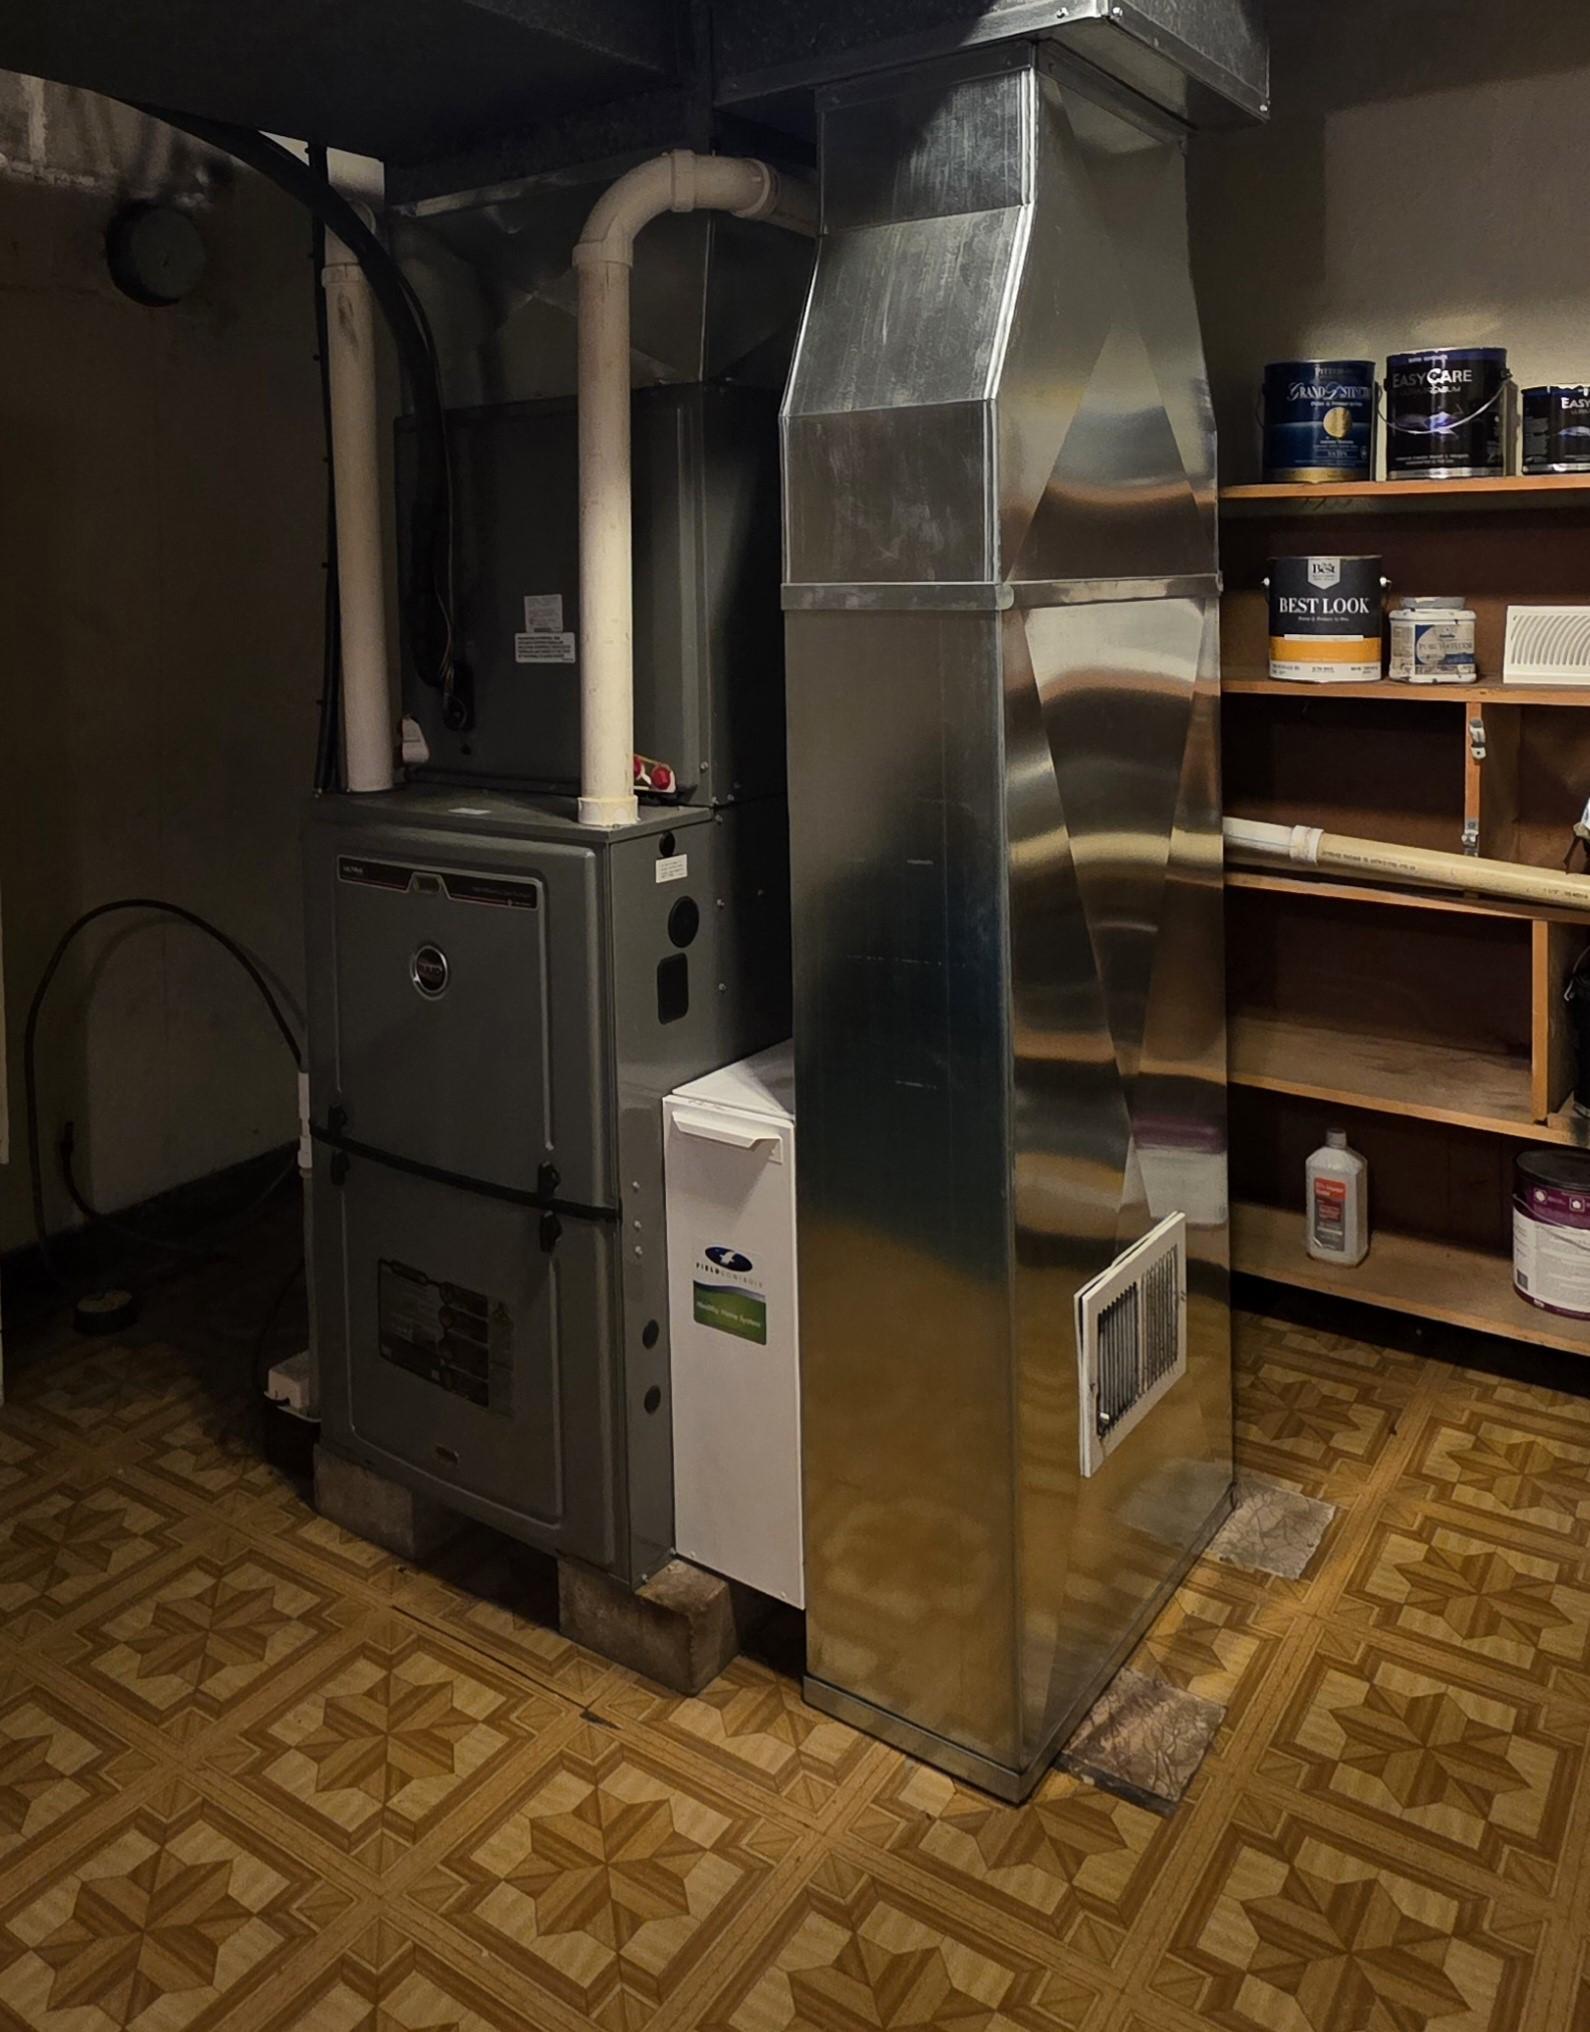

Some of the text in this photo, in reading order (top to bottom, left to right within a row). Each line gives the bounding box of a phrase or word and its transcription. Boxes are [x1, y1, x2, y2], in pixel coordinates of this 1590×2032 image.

[1392, 367, 1473, 389] EASYCARE
[1279, 597, 1370, 614] BEST LOOK
